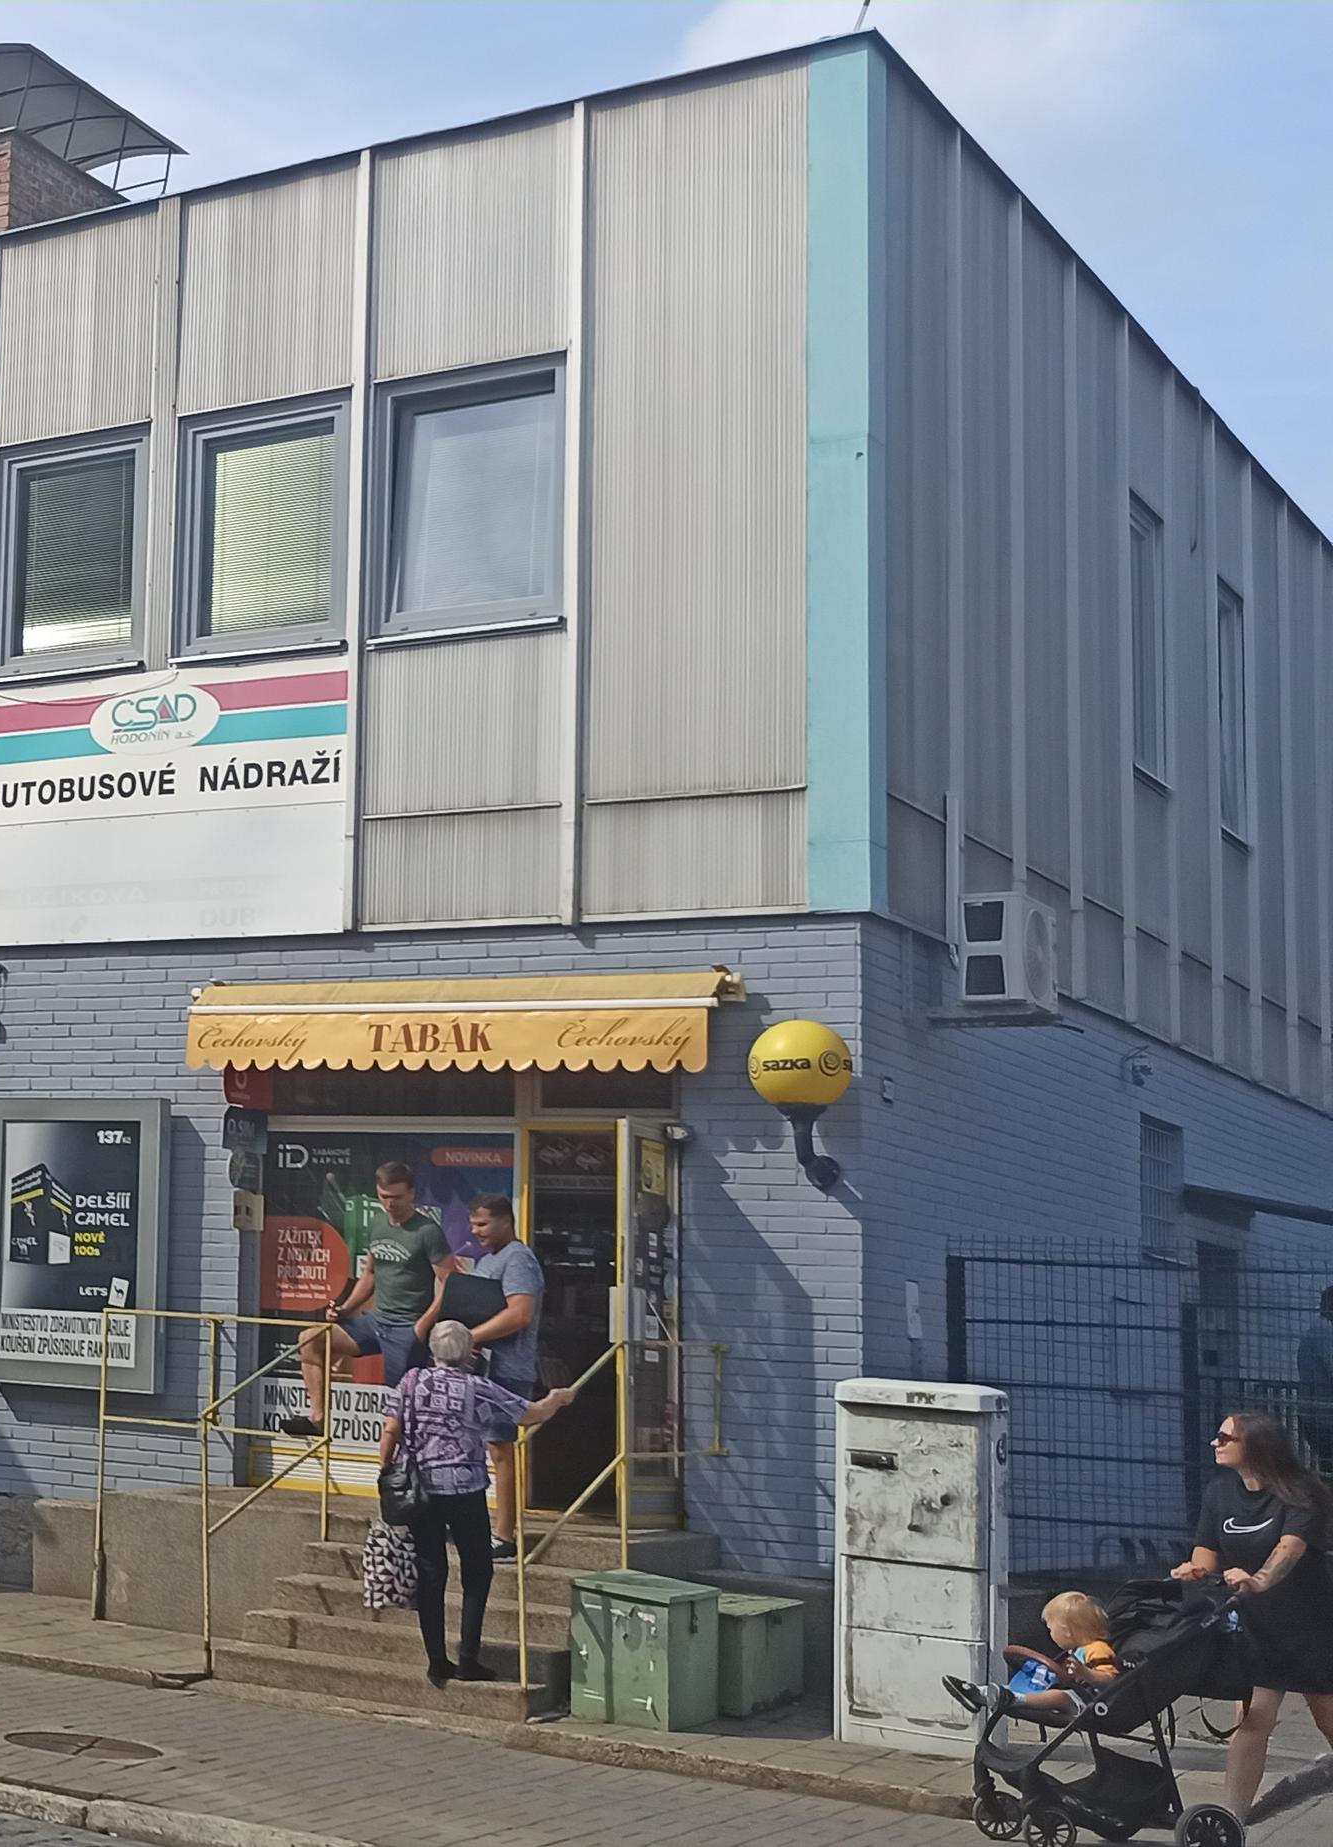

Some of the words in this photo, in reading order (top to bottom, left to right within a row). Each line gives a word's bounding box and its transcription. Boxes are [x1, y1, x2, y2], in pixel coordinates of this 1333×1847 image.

[199, 749, 342, 792] NÁDRAŽÍ
[367, 1017, 494, 1053] TABÁK
[557, 1018, 694, 1065] Čechovský
[762, 1058, 811, 1071] sazka
[96, 1130, 124, 1144] 137
[445, 1151, 503, 1164] NOVINKA
[74, 1211, 130, 1227] CAMEL
[74, 1231, 106, 1243] NOVÉ
[74, 1245, 101, 1257] 100s
[87, 1340, 132, 1361] RAKVINU
